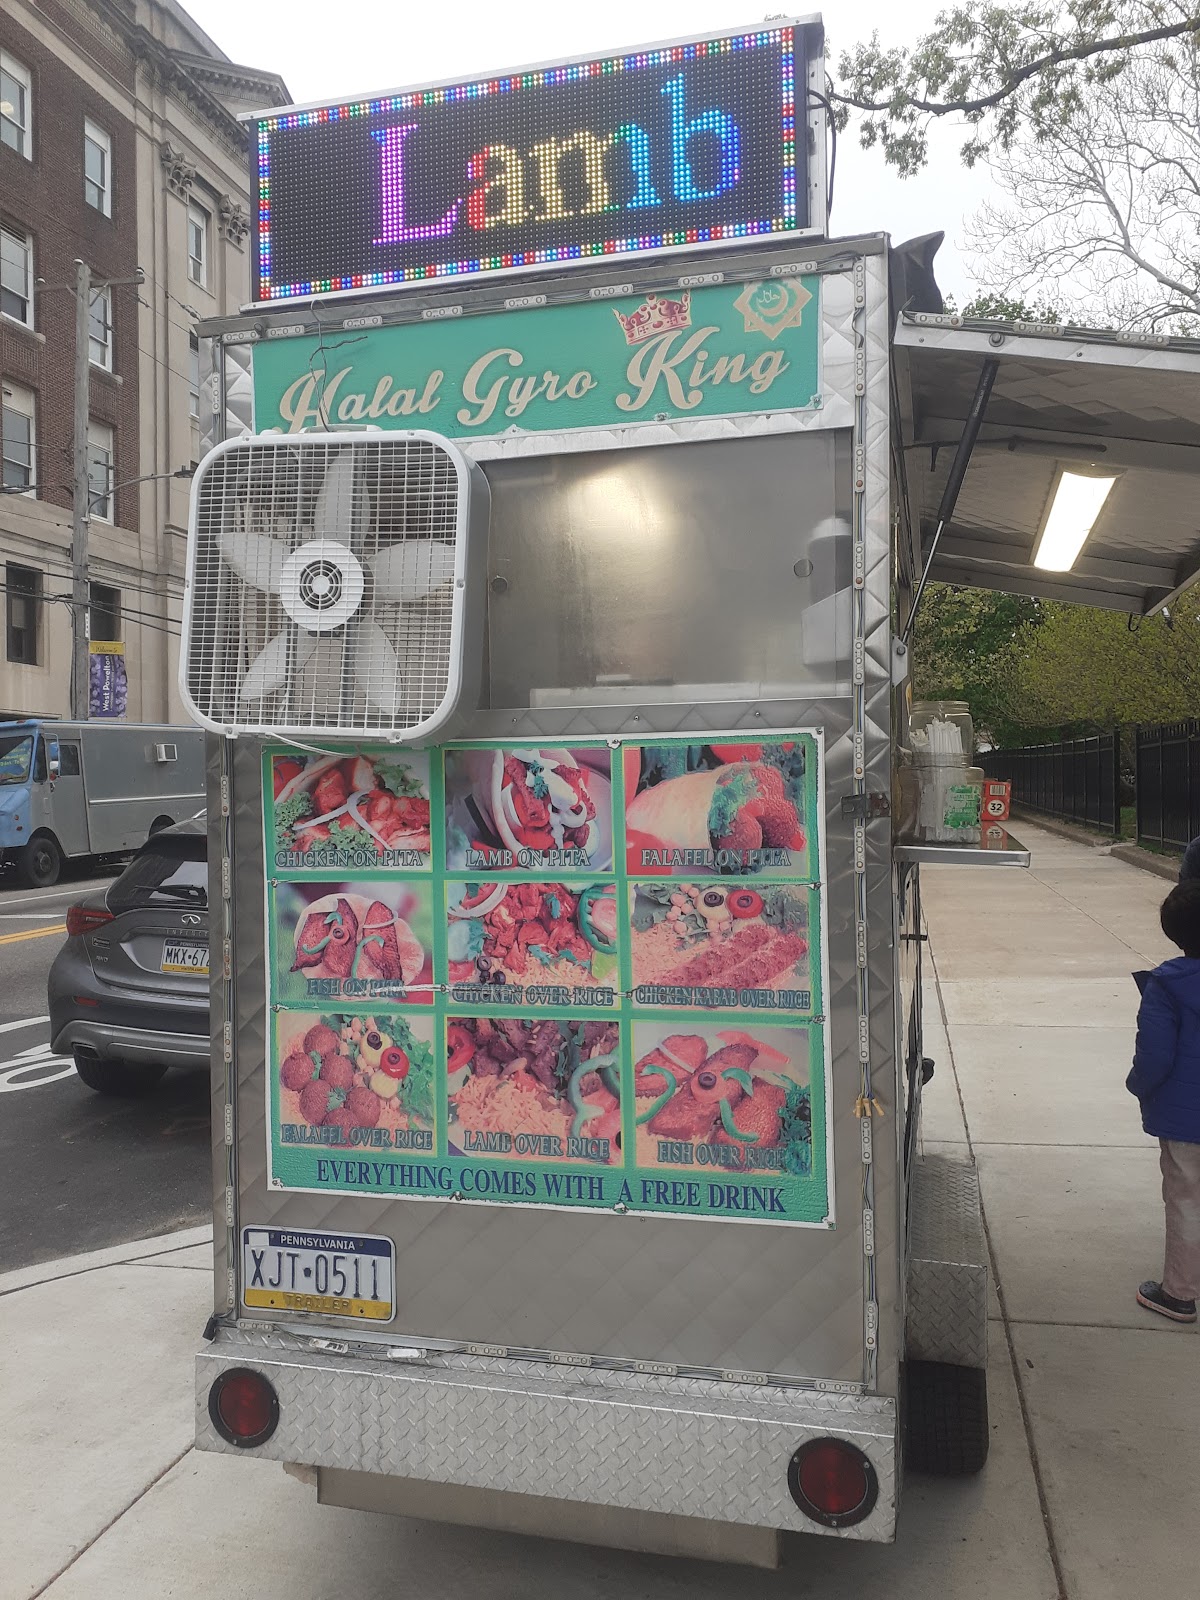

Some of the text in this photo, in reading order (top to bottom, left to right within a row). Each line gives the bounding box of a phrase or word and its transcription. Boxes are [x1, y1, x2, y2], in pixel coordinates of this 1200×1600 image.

[371, 74, 740, 246] Lamb
[275, 327, 790, 433] Halal Gyro King
[990, 802, 1003, 812] 32
[274, 849, 423, 867] CHICKEN ON PITA
[465, 849, 590, 867] LAMB ON PITA
[641, 849, 791, 868] FALAFEL ON PITA
[166, 929, 209, 937] INFINIT
[306, 977, 341, 996] FISH
[342, 977, 369, 998] ON
[451, 982, 614, 1007] CHICKEN OVER RICE
[636, 985, 811, 1010] CHICKEN KABAB OVER RICE
[281, 1123, 433, 1151] FALAFEL OVER RICE
[464, 1130, 611, 1160] LAMB OVER RICE
[657, 1140, 786, 1171] FISH OVER RICE
[316, 1158, 787, 1214] EVERYTHING COMES WITH A FREE DRINK
[280, 1234, 356, 1251] PENNSYLVANIA
